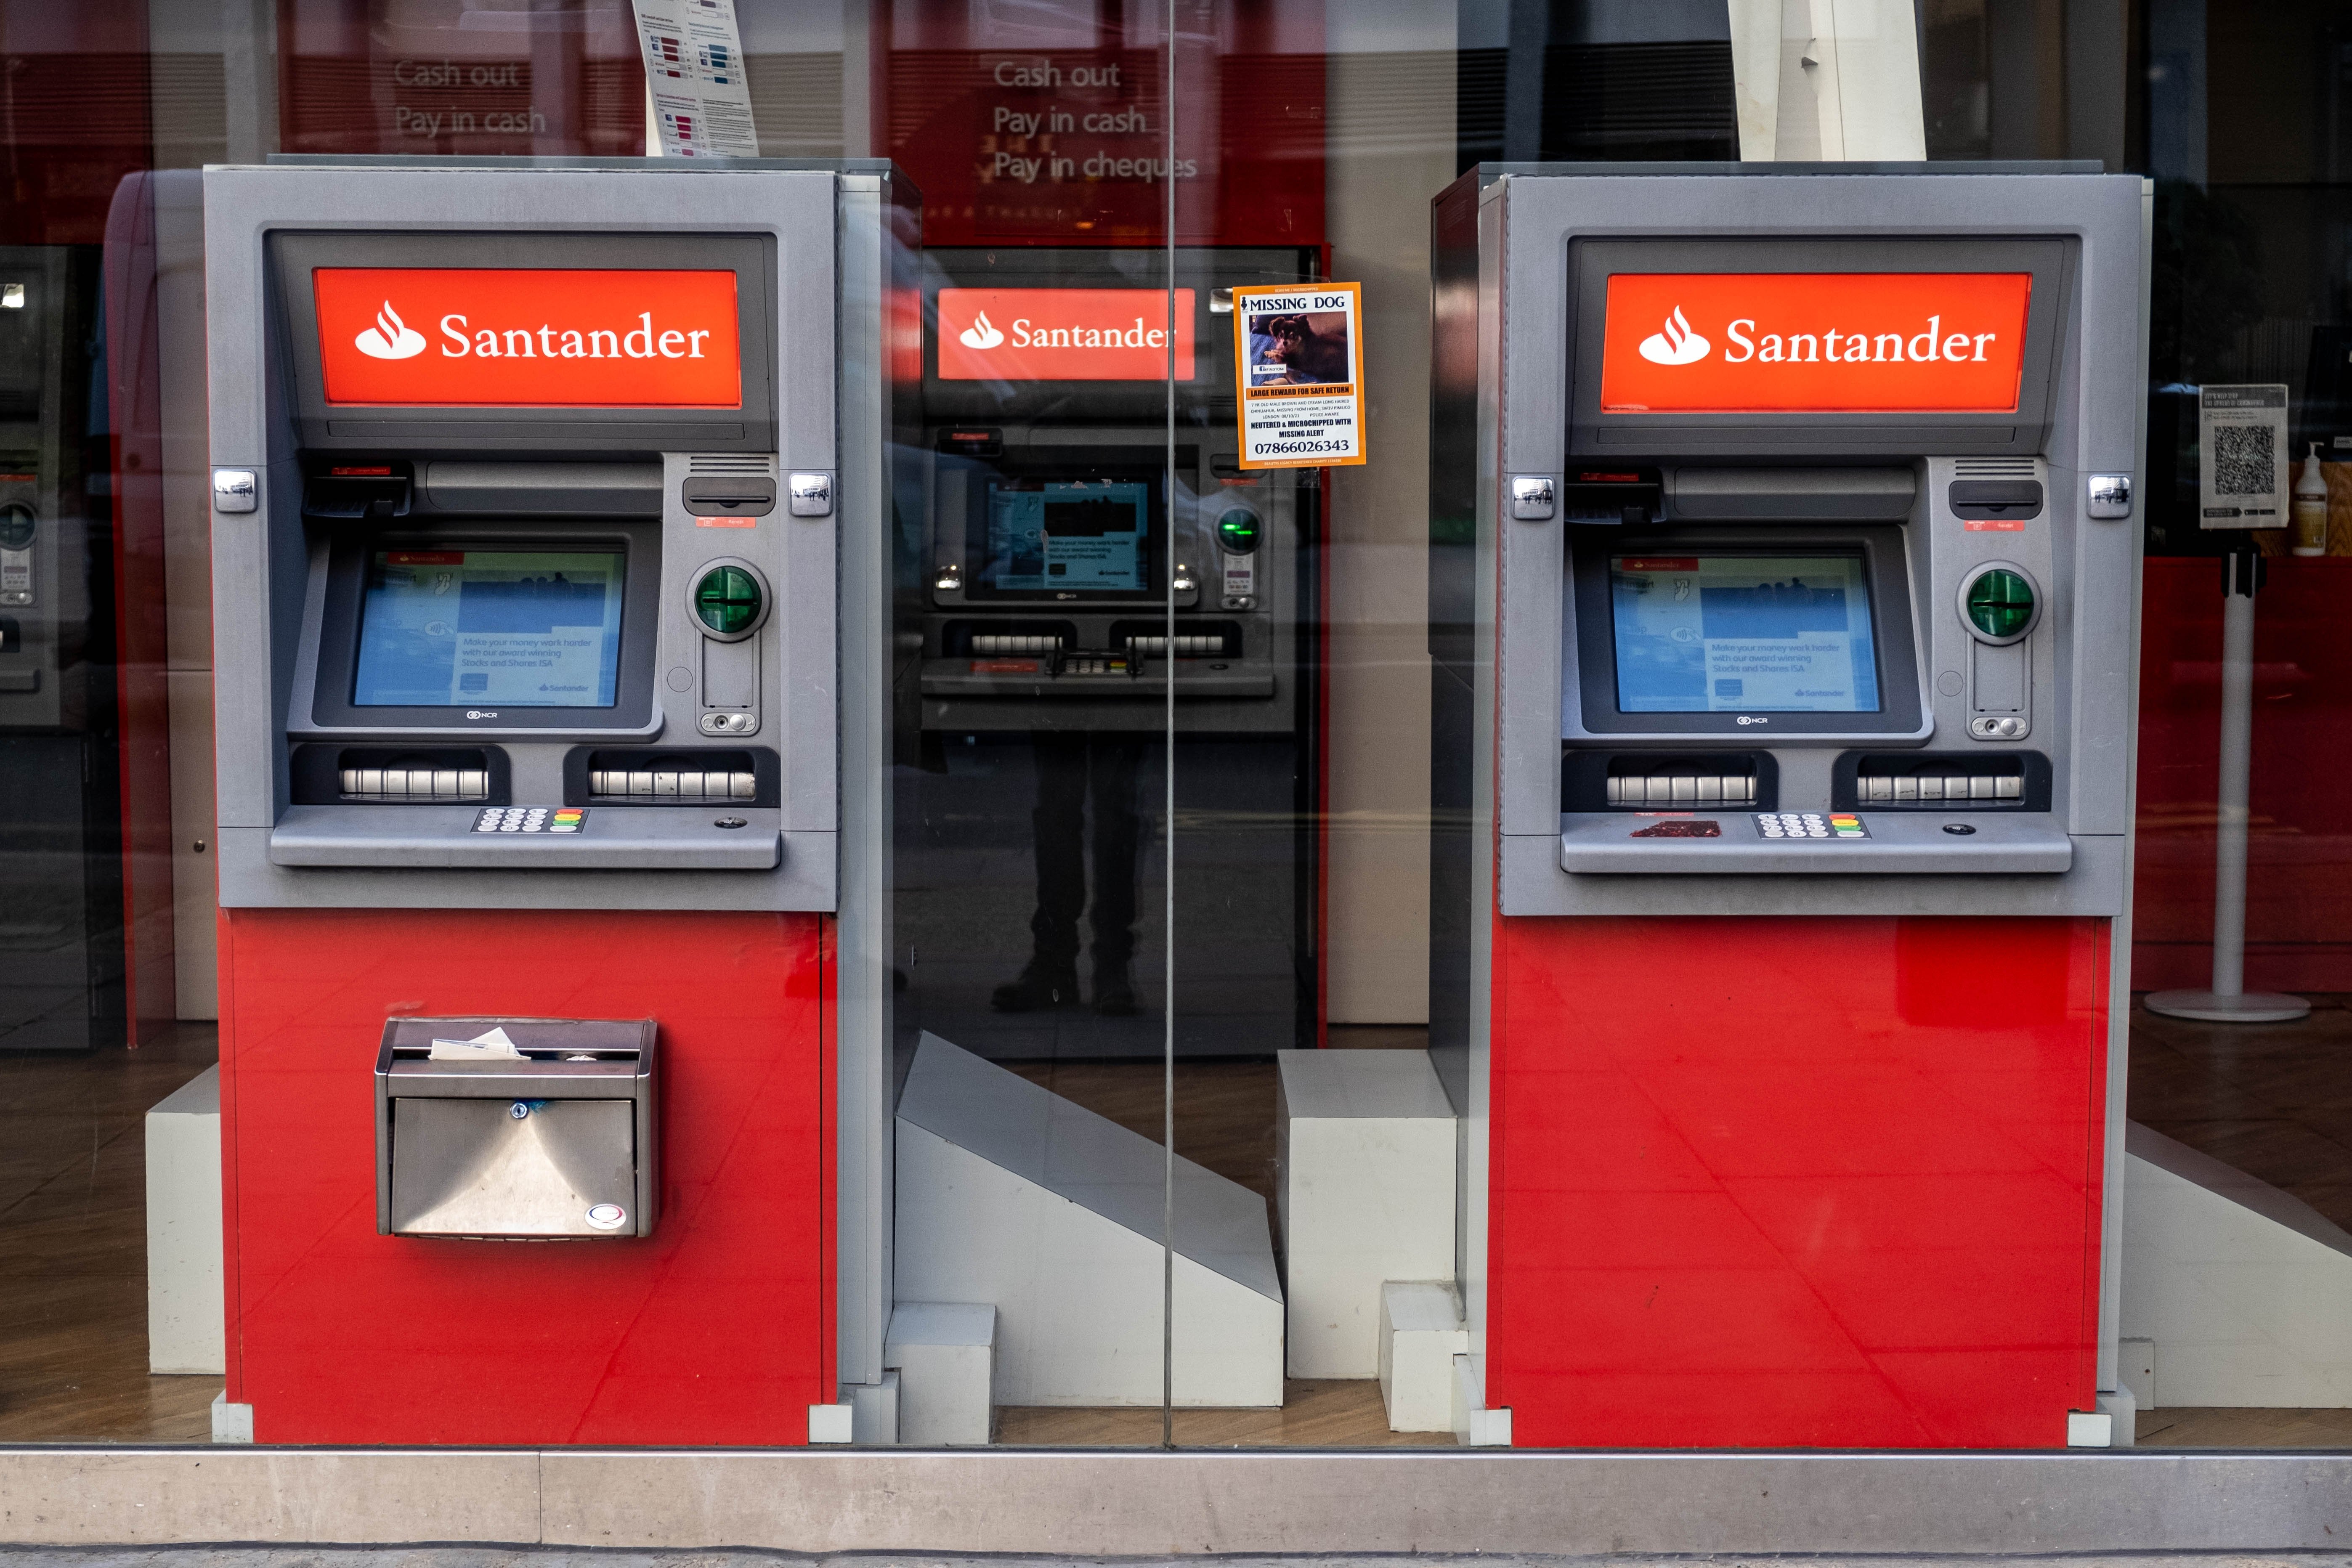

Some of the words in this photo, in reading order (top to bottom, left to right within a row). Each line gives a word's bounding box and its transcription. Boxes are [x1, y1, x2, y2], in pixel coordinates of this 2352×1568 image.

[394, 58, 461, 85] Cash
[470, 61, 519, 85] out
[995, 59, 1061, 87] Cash
[1071, 62, 1120, 87] out
[396, 106, 442, 139] Pay
[451, 105, 475, 132] in
[484, 105, 546, 133] cash
[994, 107, 1041, 139] Pay
[1051, 106, 1073, 133] in
[1083, 105, 1146, 133] cash
[994, 152, 1042, 184] Pay
[1051, 150, 1074, 177] in
[1083, 151, 1197, 183] cheques
[1250, 298, 1307, 311] MISSING
[1314, 296, 1345, 308] DOG
[441, 312, 709, 359] Santander
[1011, 317, 1176, 348] Santander
[1725, 314, 1995, 363] Santander
[1288, 419, 1334, 427] MICROCHIPPED
[1255, 440, 1349, 454] 07866026343
[508, 659, 537, 667] Shares
[528, 649, 561, 658] winning
[1778, 655, 1811, 663] winning
